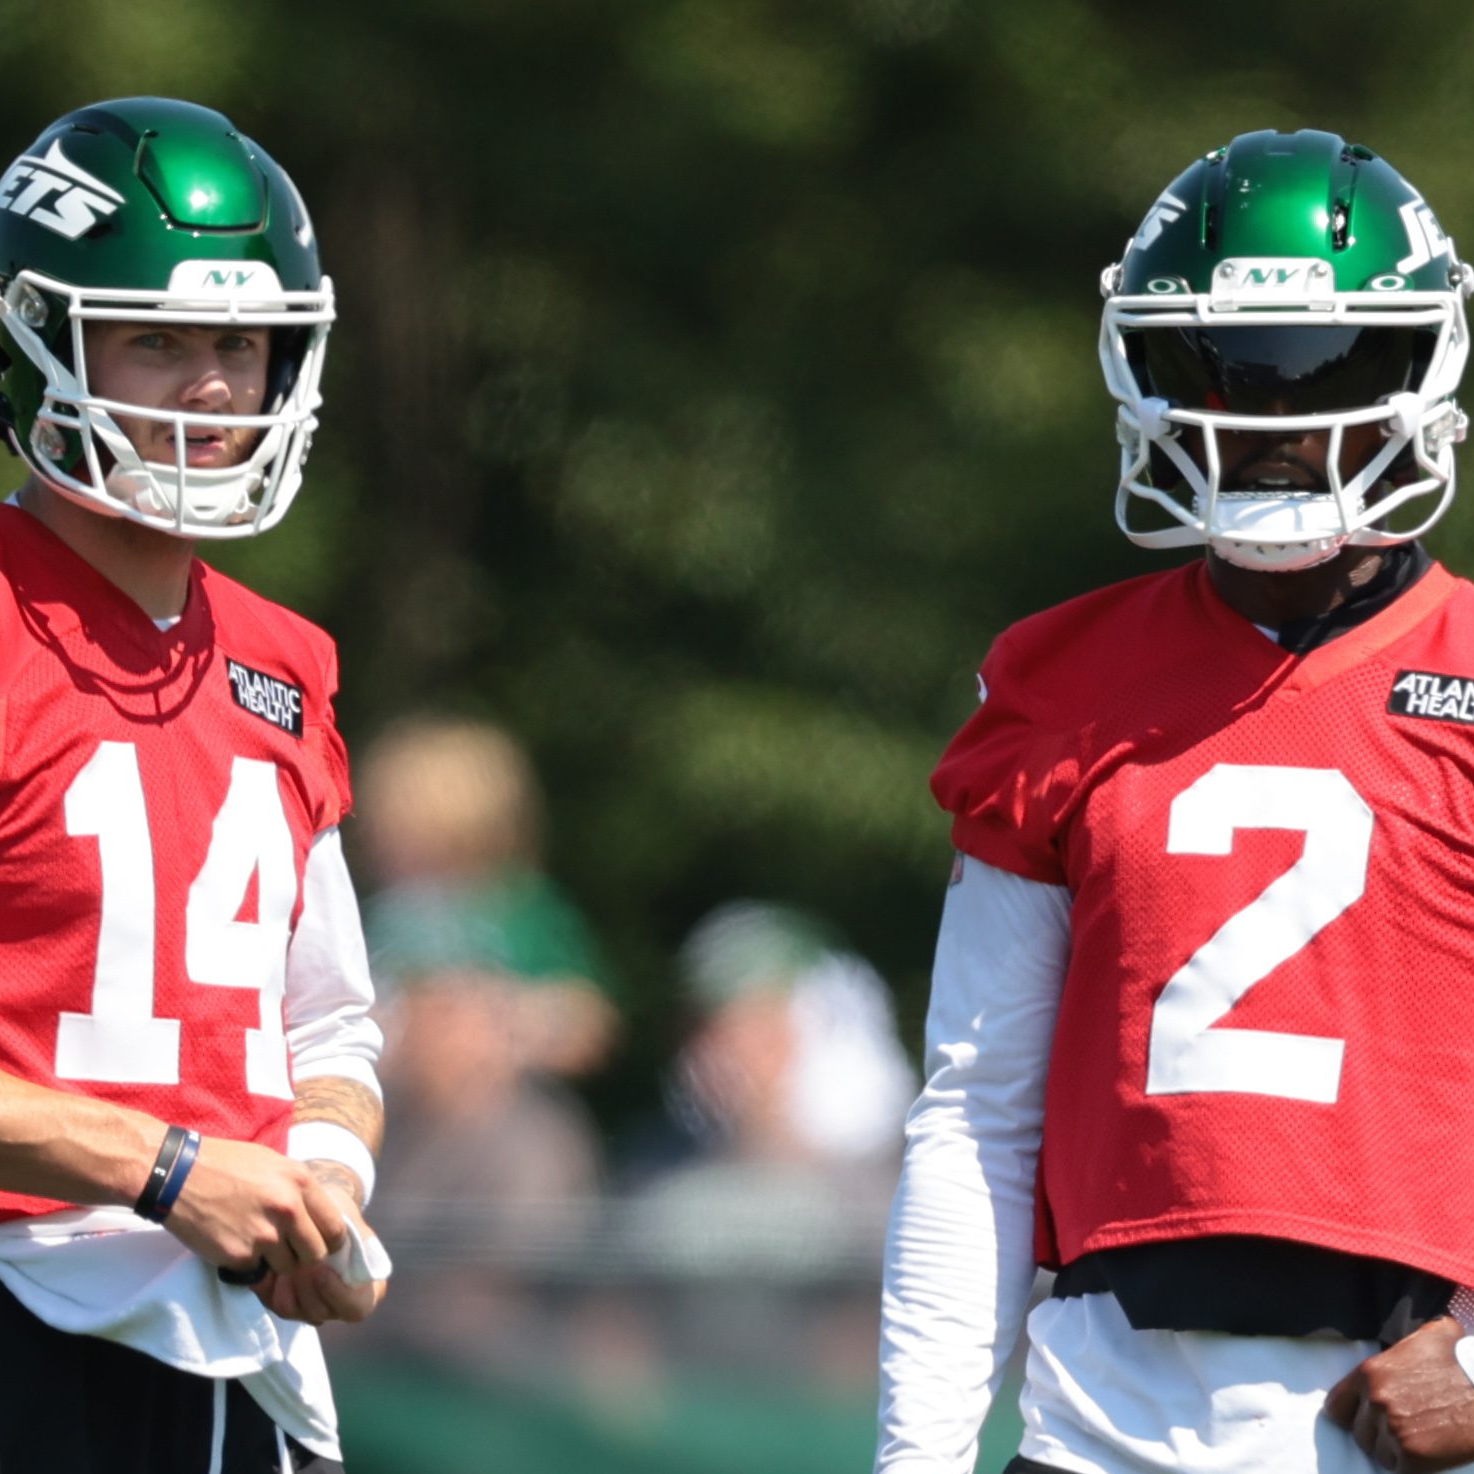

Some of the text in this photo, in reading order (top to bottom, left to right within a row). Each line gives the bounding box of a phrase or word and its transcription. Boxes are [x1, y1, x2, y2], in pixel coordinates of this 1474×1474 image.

[1242, 268, 1300, 287] NY
[228, 661, 302, 714] ATLANTIC
[237, 684, 294, 731] HEALTH
[54, 740, 296, 1100] 14
[1145, 763, 1375, 1103] 2
